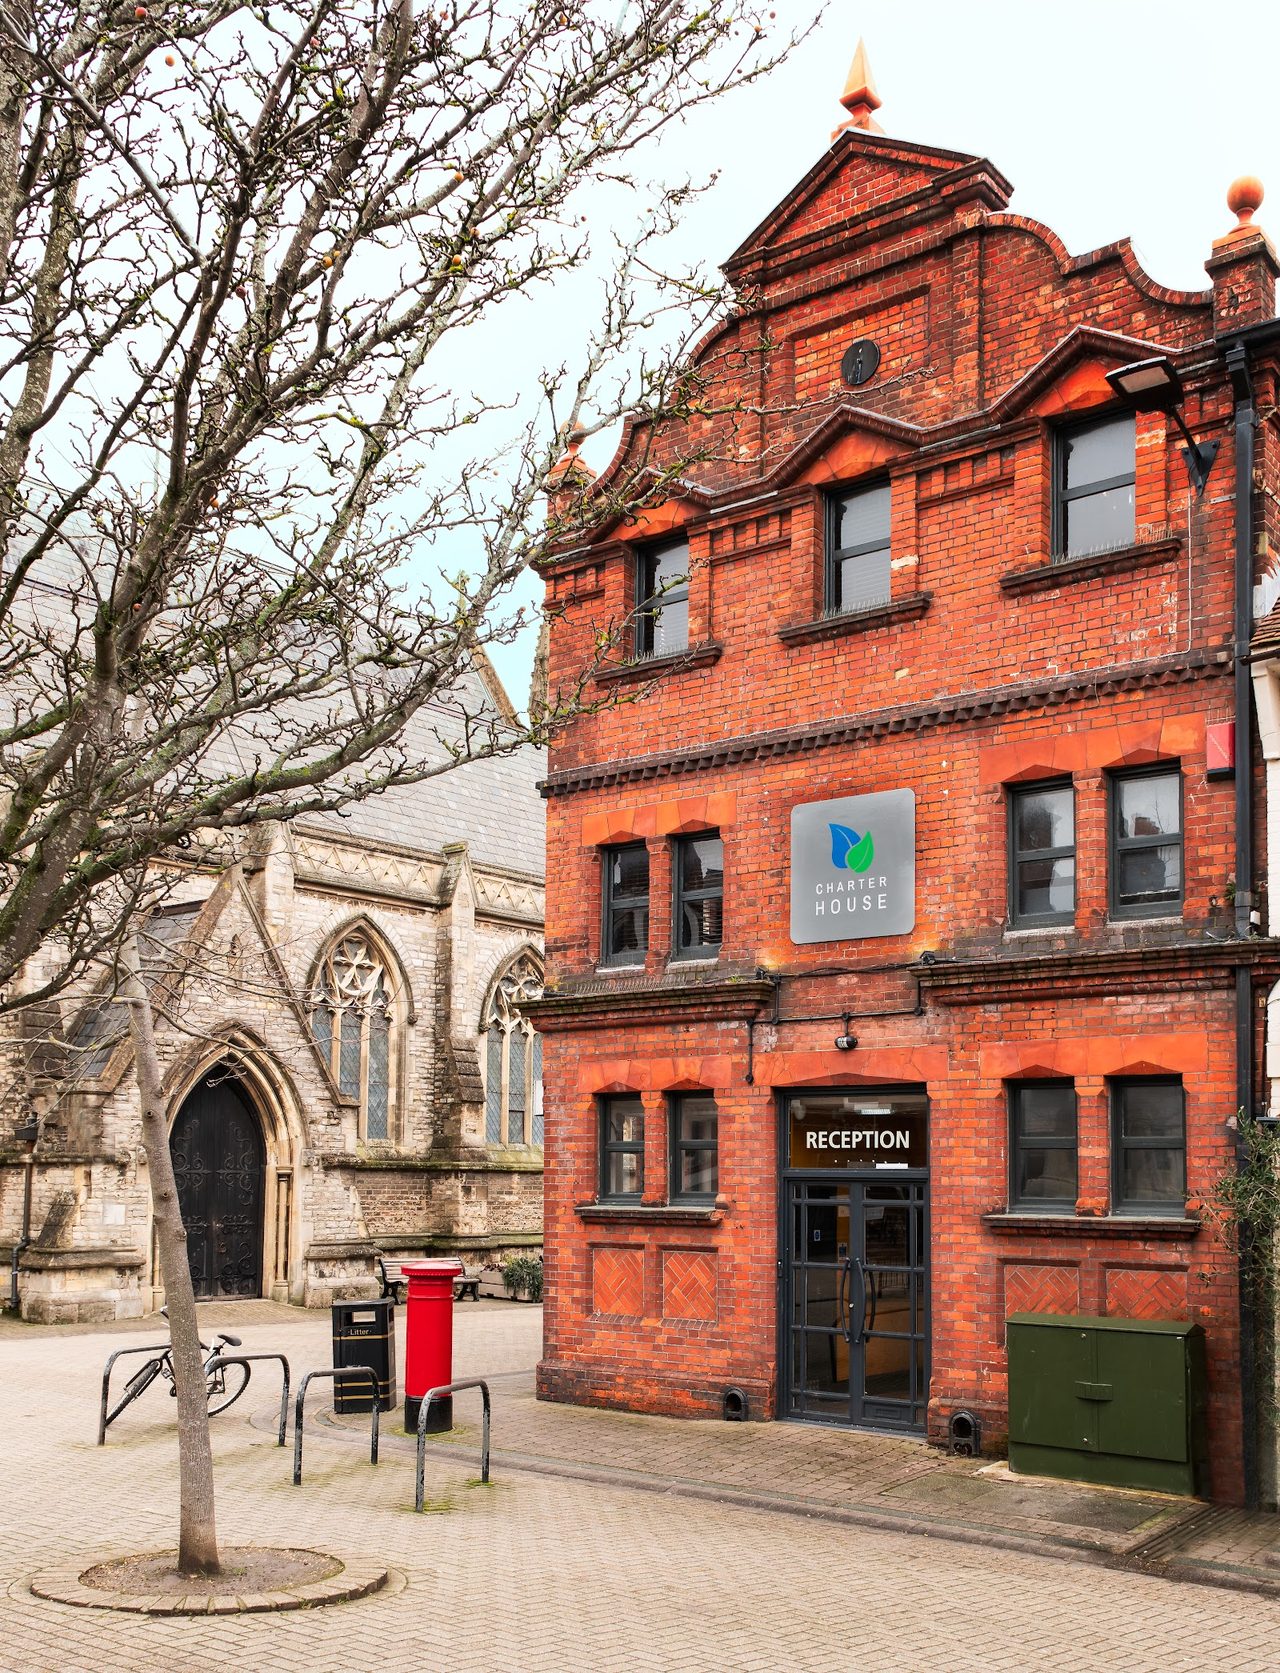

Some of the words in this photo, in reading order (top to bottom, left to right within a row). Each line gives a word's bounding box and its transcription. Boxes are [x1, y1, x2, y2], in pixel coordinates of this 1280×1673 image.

[815, 876, 887, 895] CHARTER
[815, 893, 887, 916] HOUSE
[806, 1130, 910, 1149] RECEPTION
[350, 1328, 370, 1336] Litter
